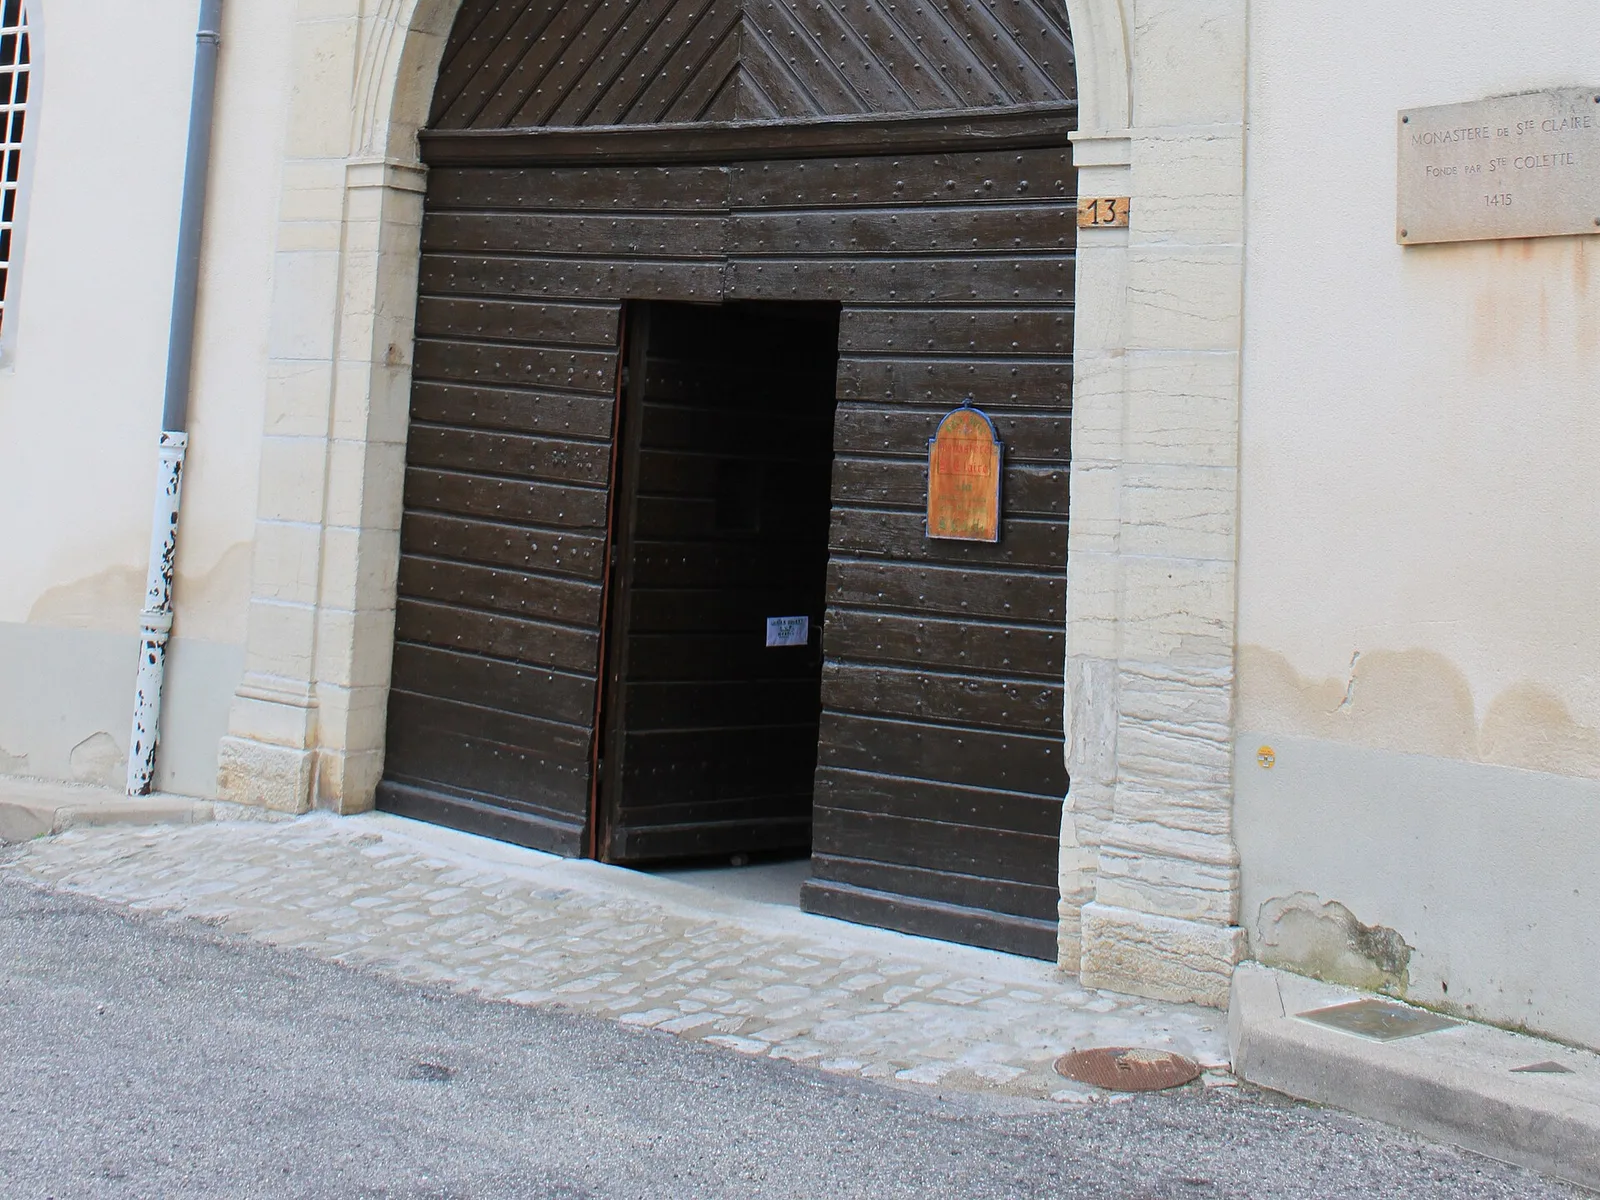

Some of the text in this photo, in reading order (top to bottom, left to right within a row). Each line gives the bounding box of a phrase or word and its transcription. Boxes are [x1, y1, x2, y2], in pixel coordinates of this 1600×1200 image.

[1411, 126, 1490, 146] MONASTERE
[1496, 127, 1509, 137] DE
[1541, 115, 1592, 133] CLAIRE
[1464, 164, 1481, 174] PAR
[1513, 153, 1575, 170] COLETTE
[1087, 199, 1116, 224] 13
[1484, 193, 1513, 207] 1415
